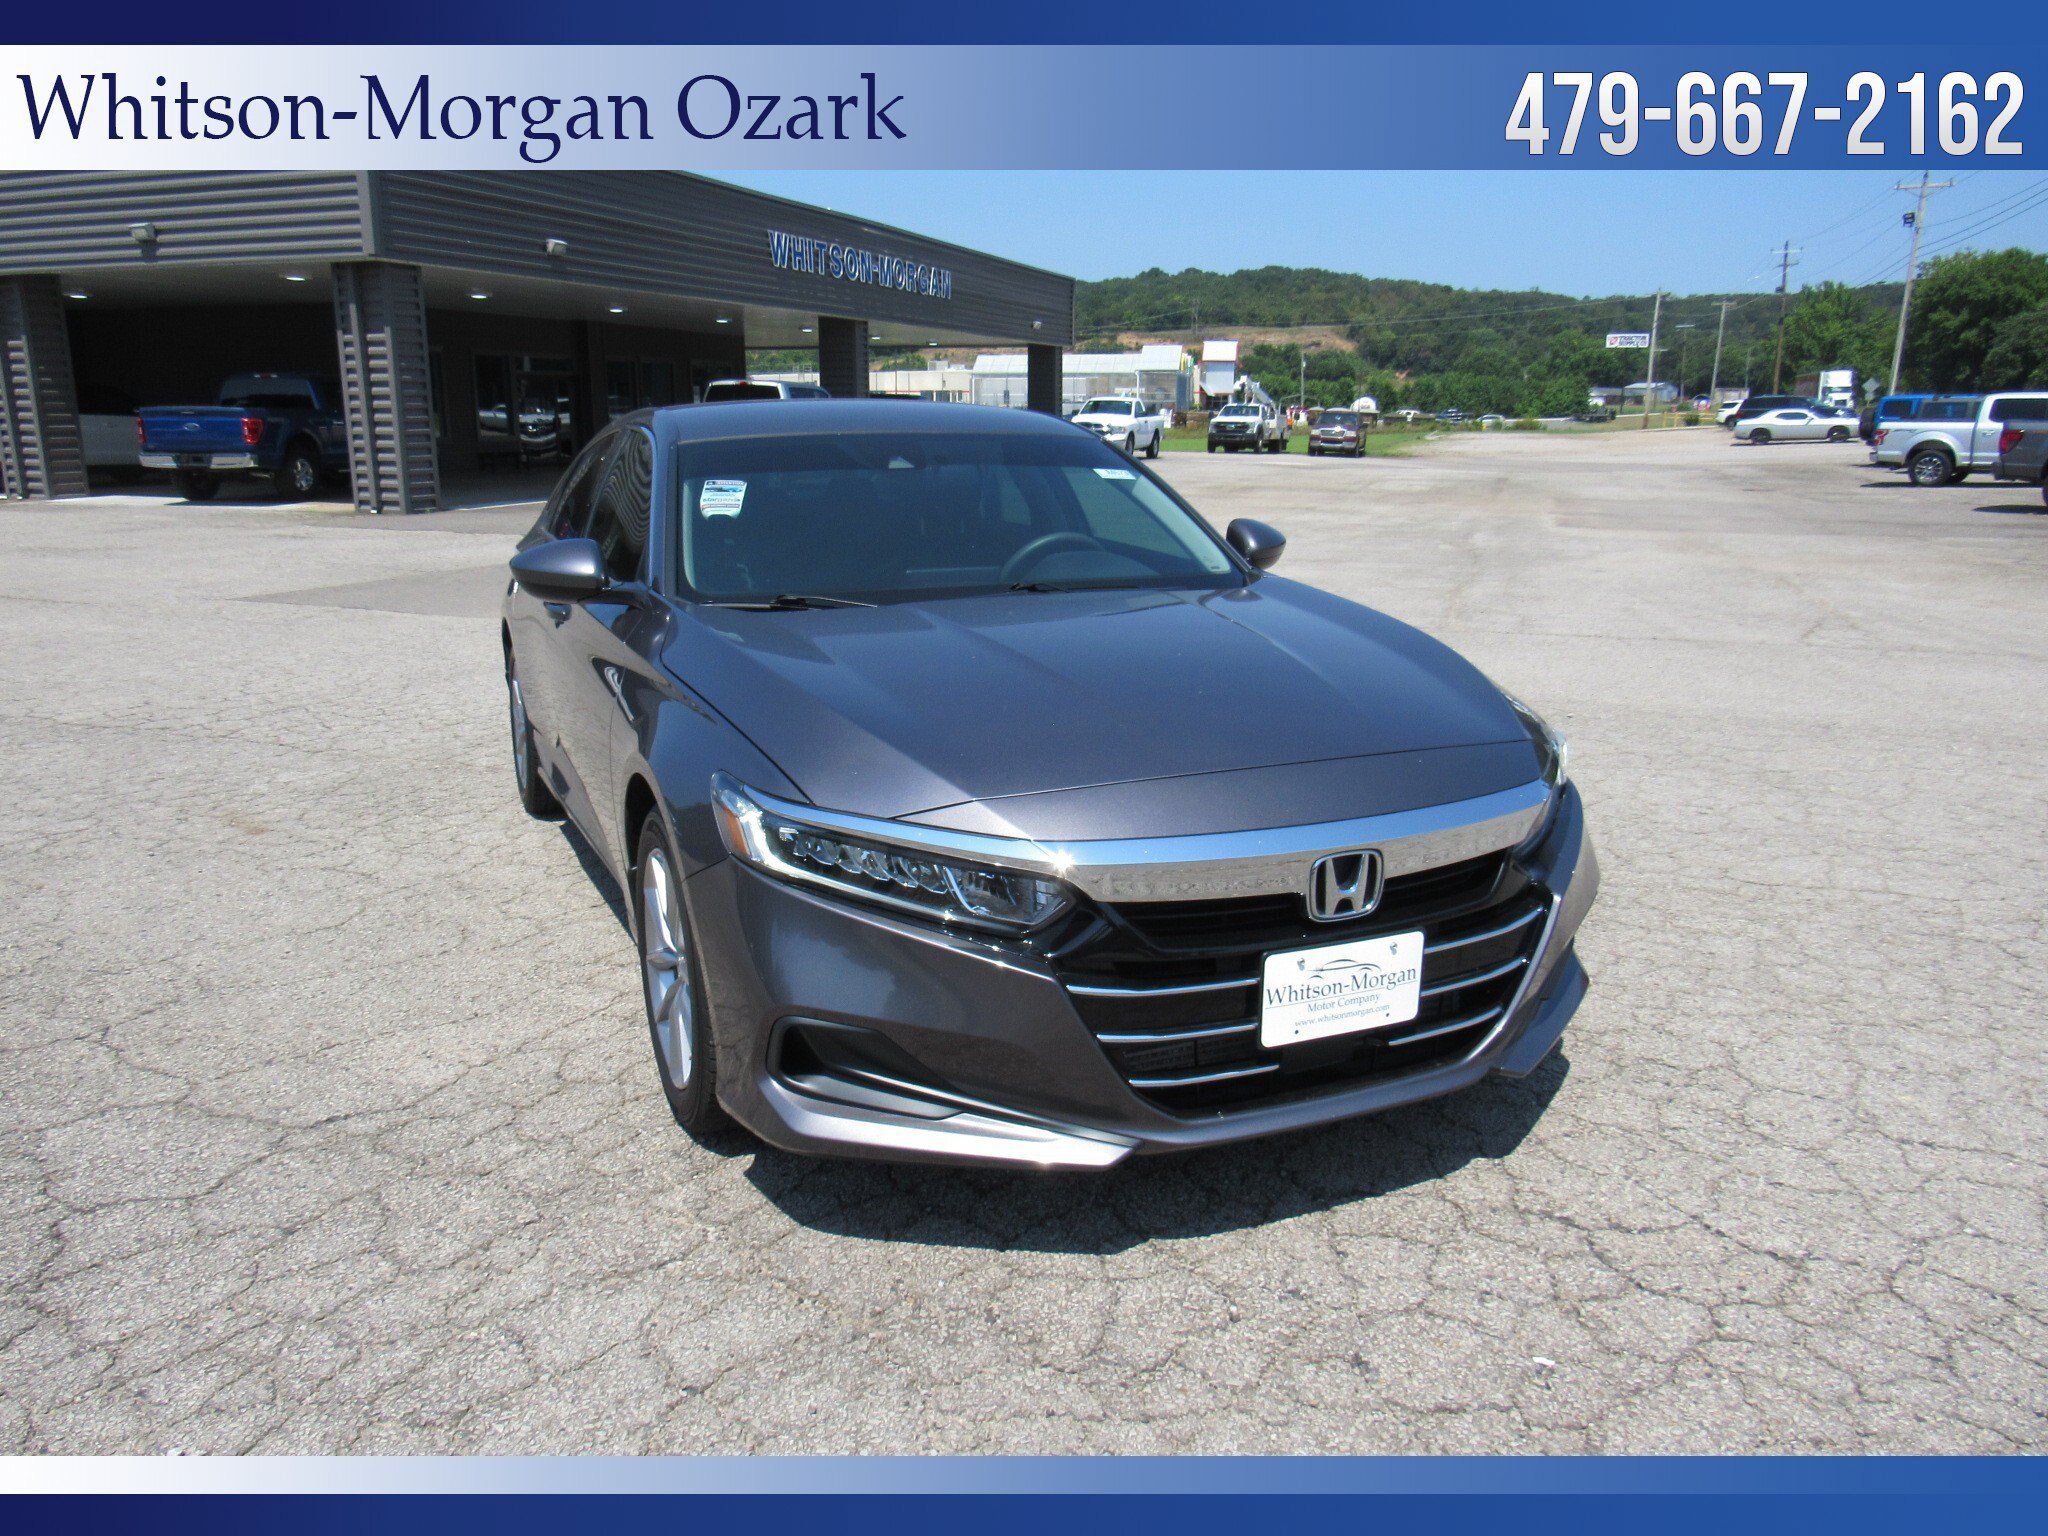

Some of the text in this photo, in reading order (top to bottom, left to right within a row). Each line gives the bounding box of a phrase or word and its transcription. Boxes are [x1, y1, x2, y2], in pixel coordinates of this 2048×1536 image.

[767, 229, 952, 300] WHITSON-MORGAN
[1266, 967, 1417, 1006] Whitson-Morgan
[1294, 1004, 1390, 1027] www.whitsonmorgan.com
[1307, 993, 1381, 1013] Motor Company
